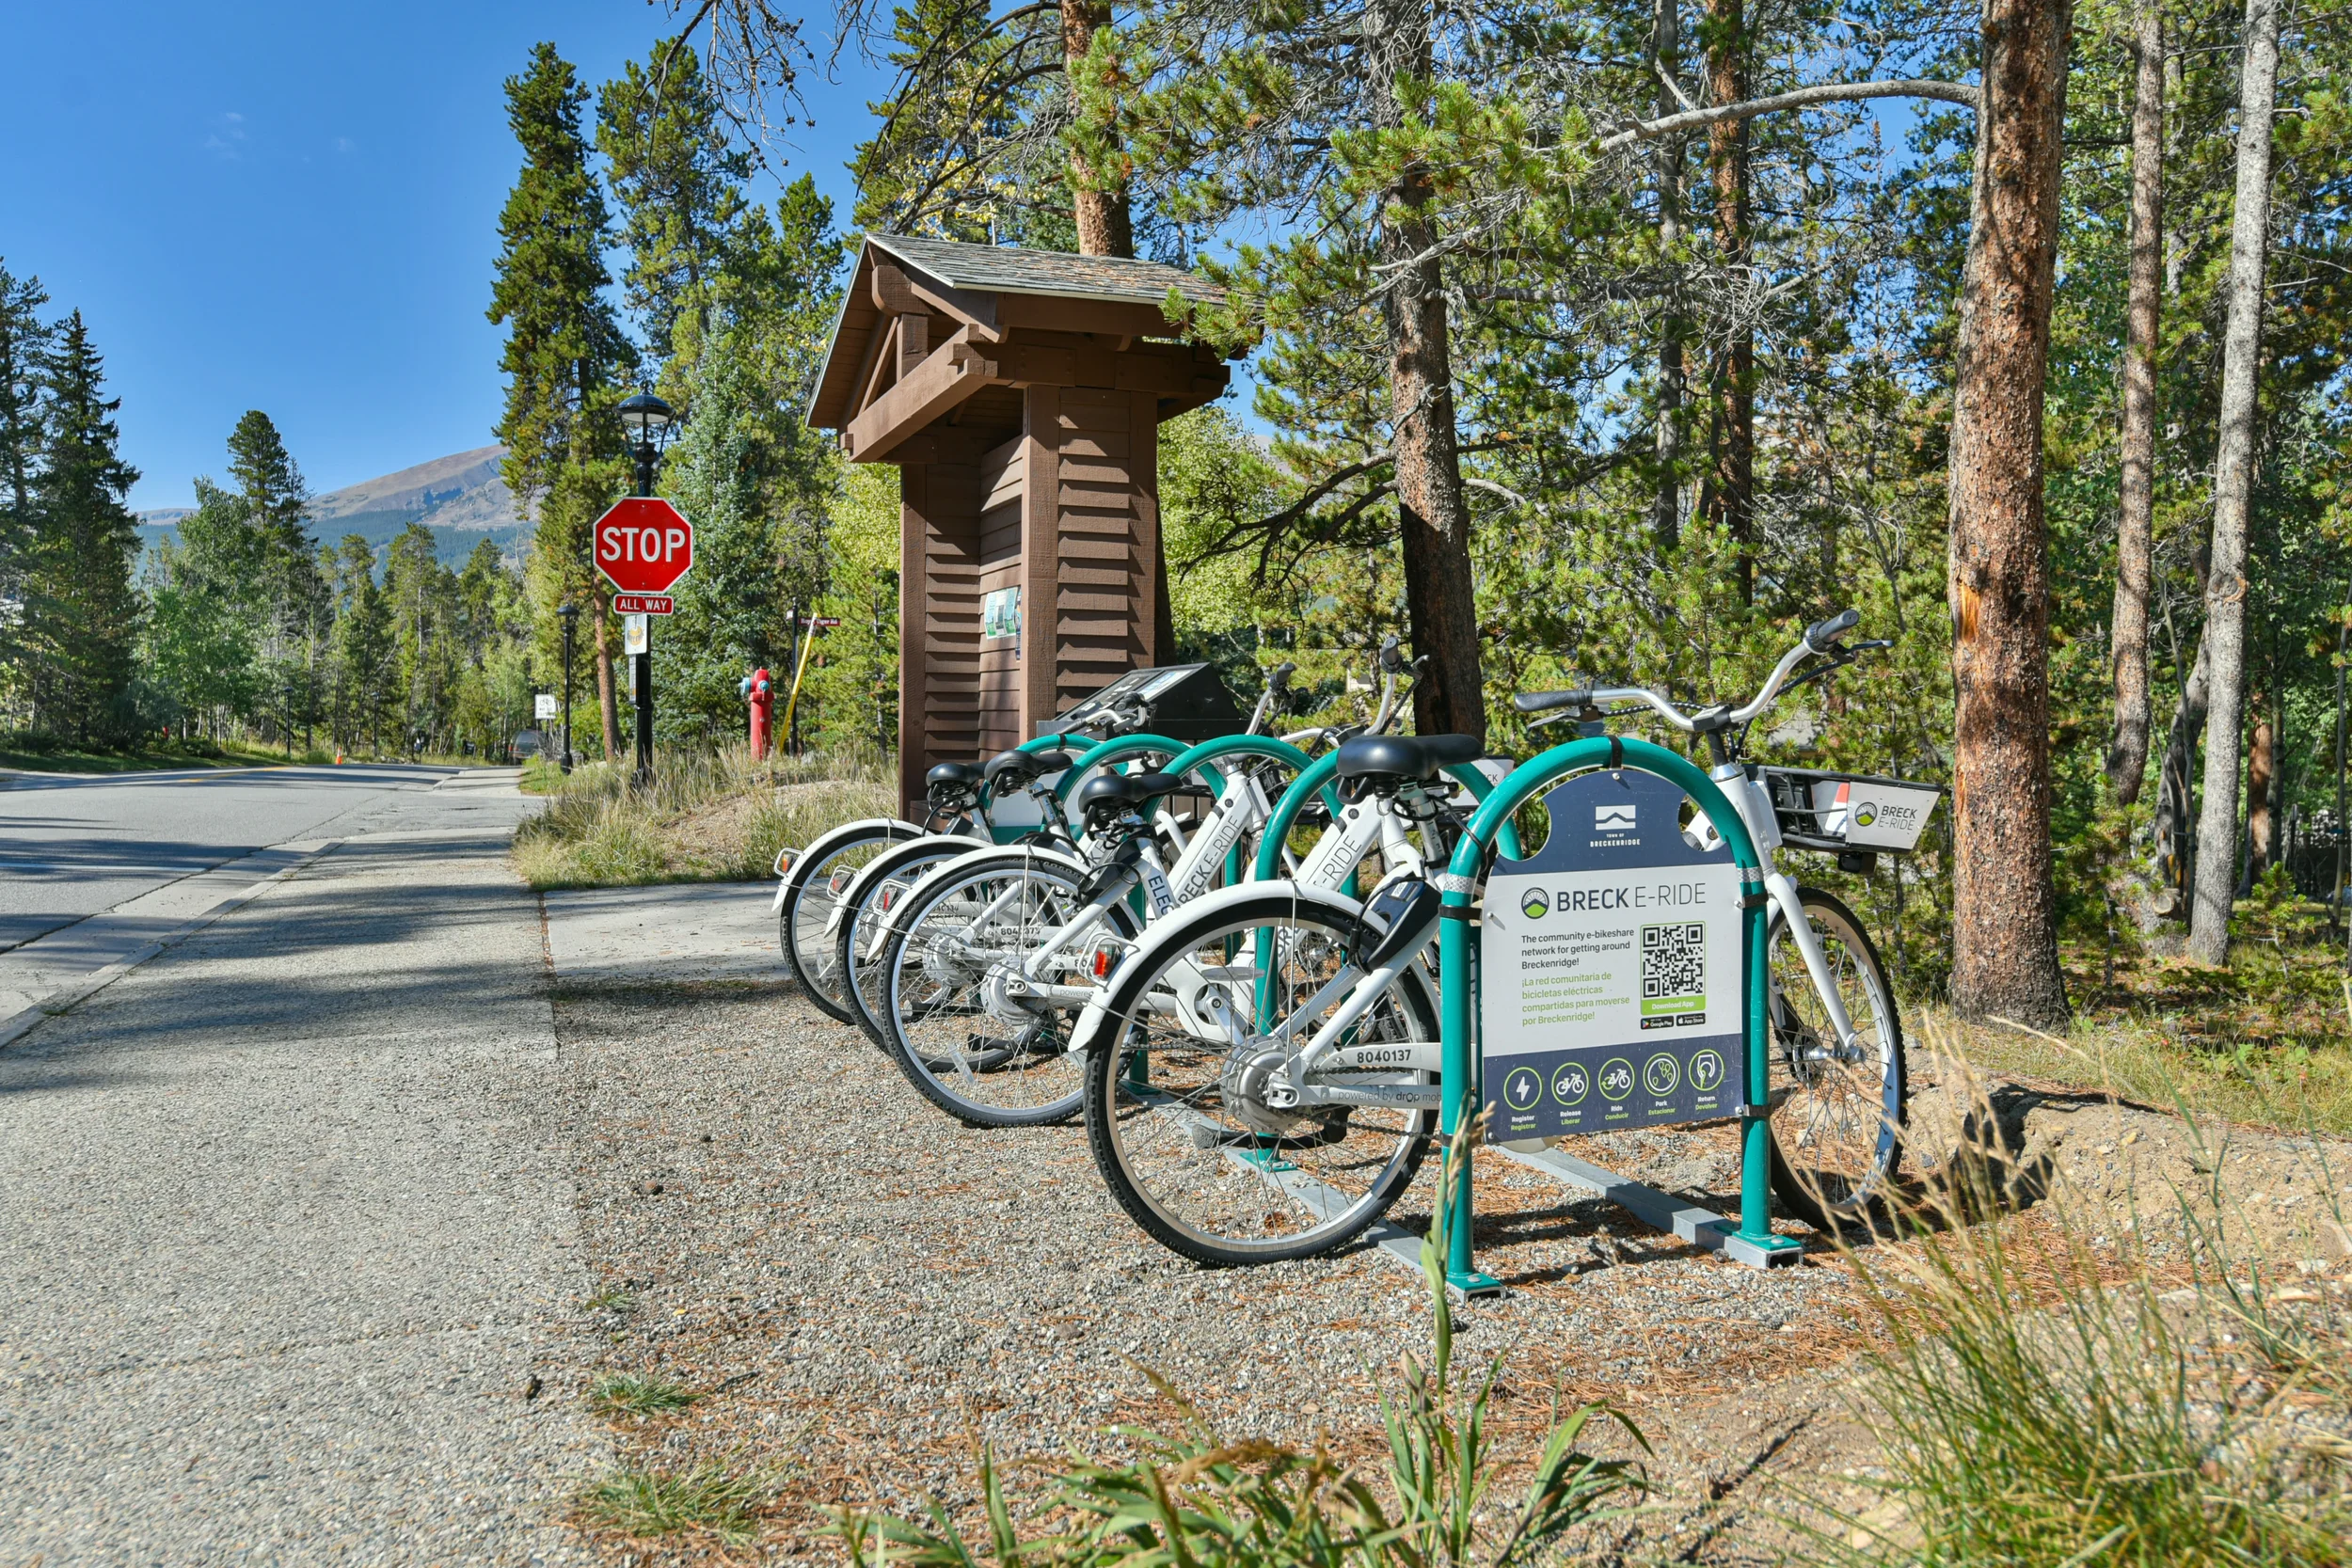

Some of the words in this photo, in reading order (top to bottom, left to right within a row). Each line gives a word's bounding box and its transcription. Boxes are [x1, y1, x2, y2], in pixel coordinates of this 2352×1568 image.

[601, 527, 686, 562] STOP
[619, 598, 641, 610] ALL
[645, 599, 668, 611] WAY
[1882, 805, 1917, 819] BRECK
[1878, 816, 1915, 831] E-RIDE
[1590, 838, 1641, 847] BRECKENRIDGE
[1176, 864, 1212, 909] RECK
[1203, 816, 1243, 869] E-RIDE
[1557, 887, 1629, 911] BRECK
[1635, 883, 1706, 908] E-RIDE
[1521, 935, 1537, 943] The
[1538, 931, 1585, 942] community
[1586, 929, 1634, 939] e-bikeshare
[1521, 946, 1555, 957] network
[1557, 945, 1569, 954] for
[1570, 943, 1600, 955] getting
[1601, 941, 1630, 951] around
[1521, 958, 1580, 970] Breckenridge!
[1522, 978, 1534, 988] ¡La
[1535, 976, 1549, 986] red
[1550, 973, 1599, 985] comunitaria
[1601, 972, 1612, 980] de
[1522, 989, 1562, 1000] bicicletas
[1563, 986, 1603, 996] eléctricas
[1522, 1001, 1575, 1013] compartidas
[1575, 999, 1594, 1009] para
[1595, 997, 1630, 1006] moverse
[1652, 1002, 1681, 1010] Download
[1522, 1018, 1536, 1027] por
[1538, 1011, 1596, 1024] Breckenridge!
[1357, 1049, 1411, 1064] 8040137
[1338, 1091, 1380, 1101] powered
[1382, 1091, 1394, 1102] by
[1604, 1112, 1629, 1120] Conducir
[1648, 1107, 1676, 1116] Estacionar
[1511, 1115, 1535, 1123] Register
